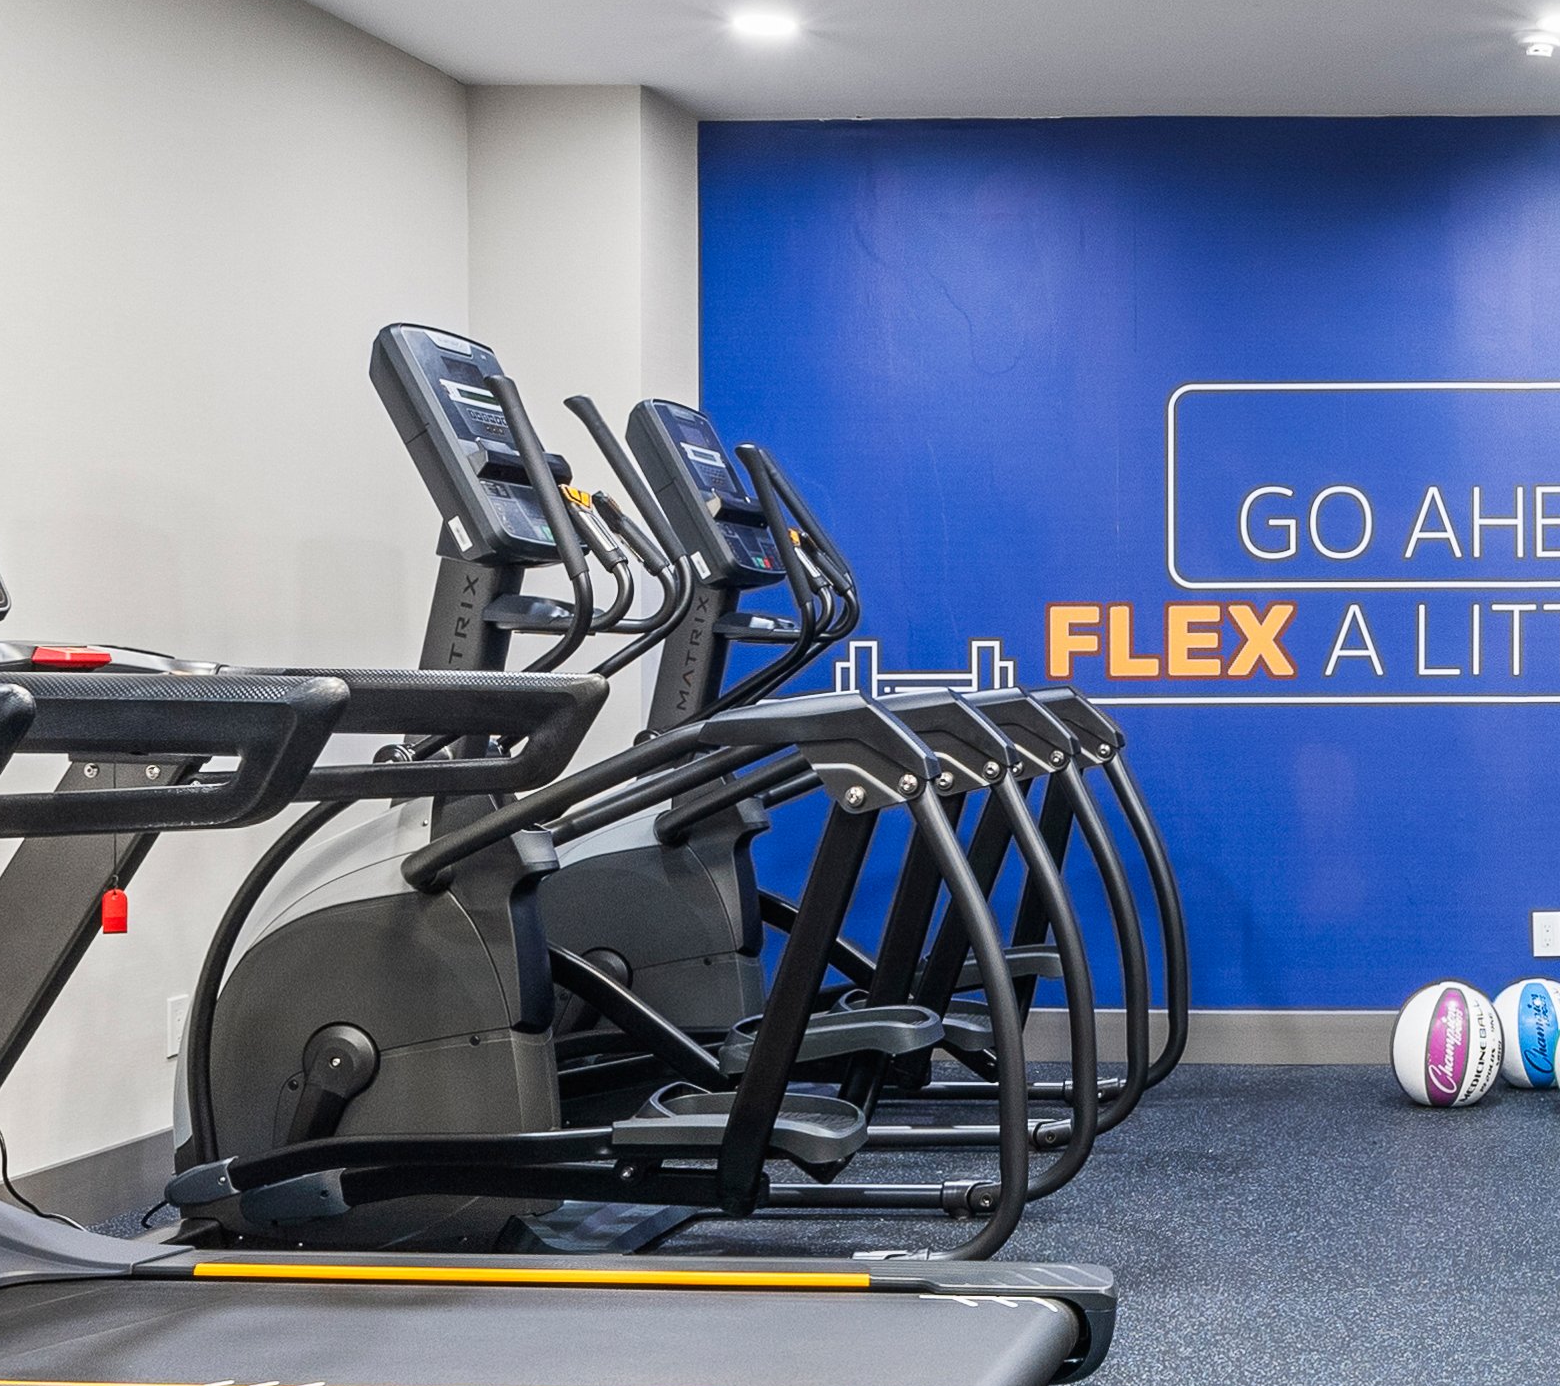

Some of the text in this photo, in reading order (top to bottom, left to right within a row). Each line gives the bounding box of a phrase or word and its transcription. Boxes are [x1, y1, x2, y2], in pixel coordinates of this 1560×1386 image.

[1239, 484, 1374, 561] GO
[448, 575, 479, 665] TRIX
[676, 596, 710, 711] MATRIX
[1046, 601, 1298, 680] FLEX
[1322, 603, 1385, 677] A
[1428, 1000, 1458, 1094] Champion
[1458, 1041, 1487, 1103] MEDICINE
